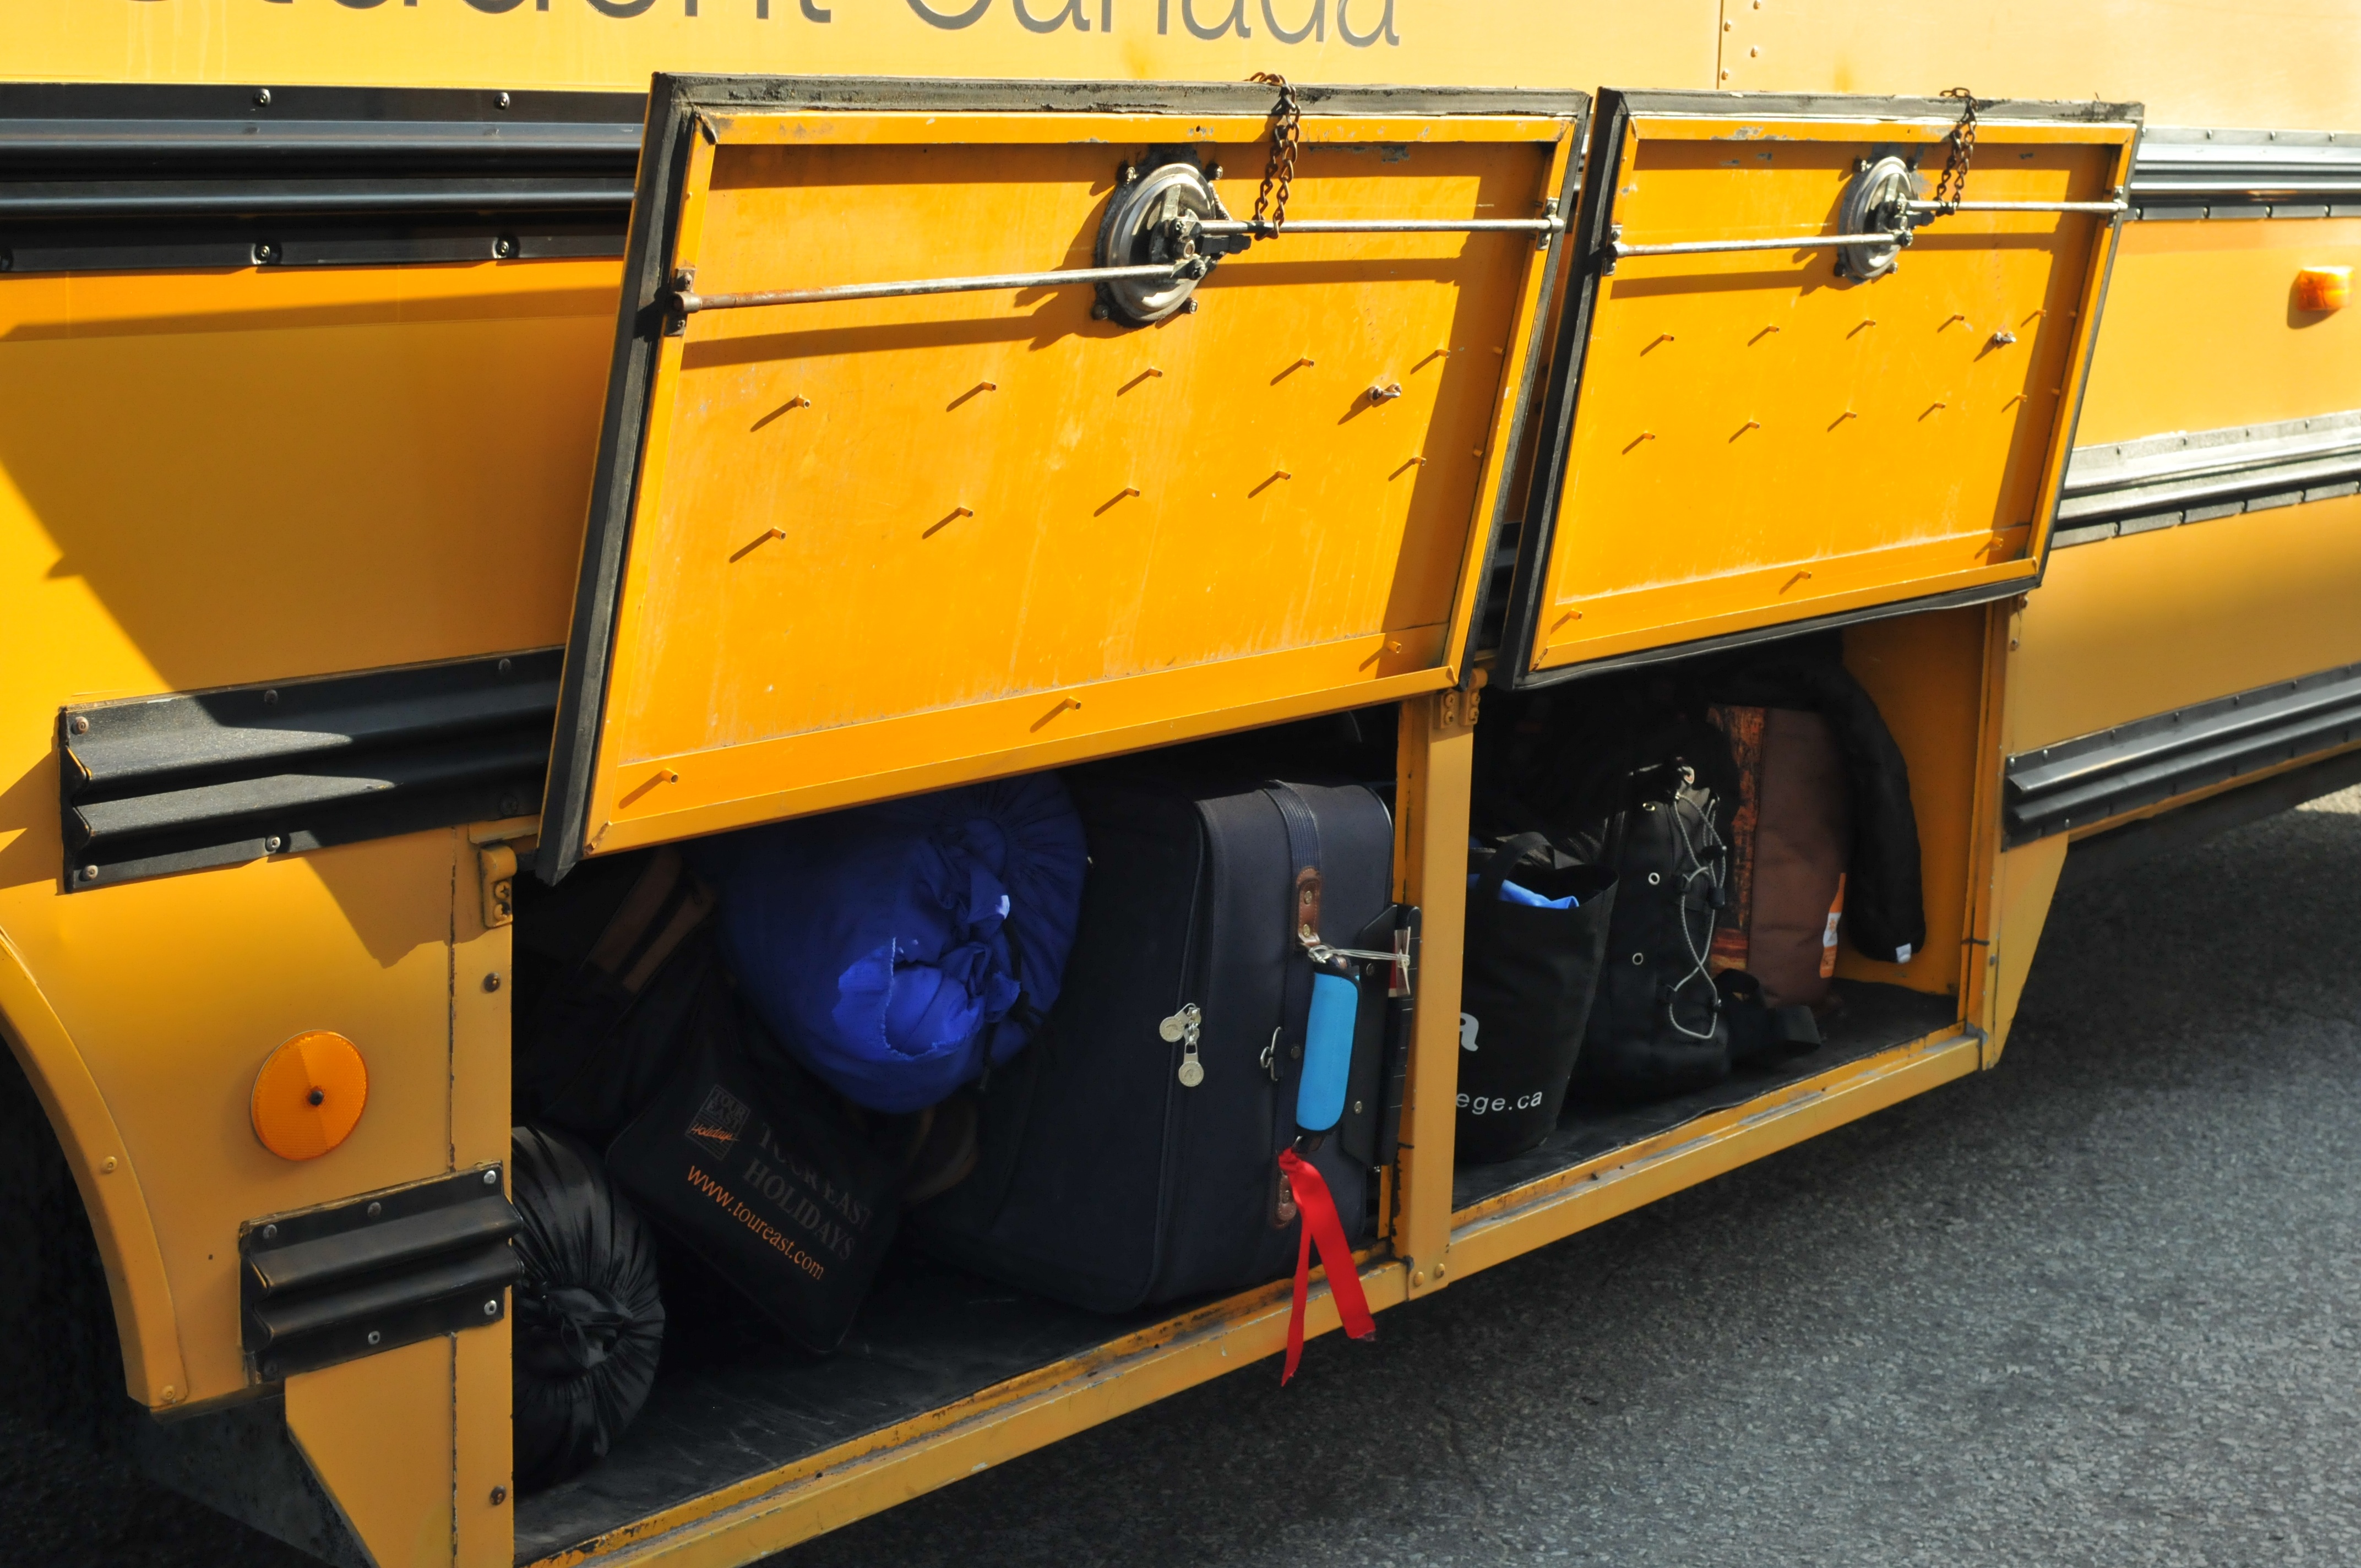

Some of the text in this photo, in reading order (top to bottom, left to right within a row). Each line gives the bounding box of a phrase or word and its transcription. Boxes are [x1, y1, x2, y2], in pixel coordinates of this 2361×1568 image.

[704, 1099, 742, 1130] EAST
[715, 1088, 747, 1120] TOUR
[759, 1123, 818, 1191] TR
[687, 1165, 824, 1280] www.toureast.com
[743, 1158, 856, 1260] HOLIDAYS
